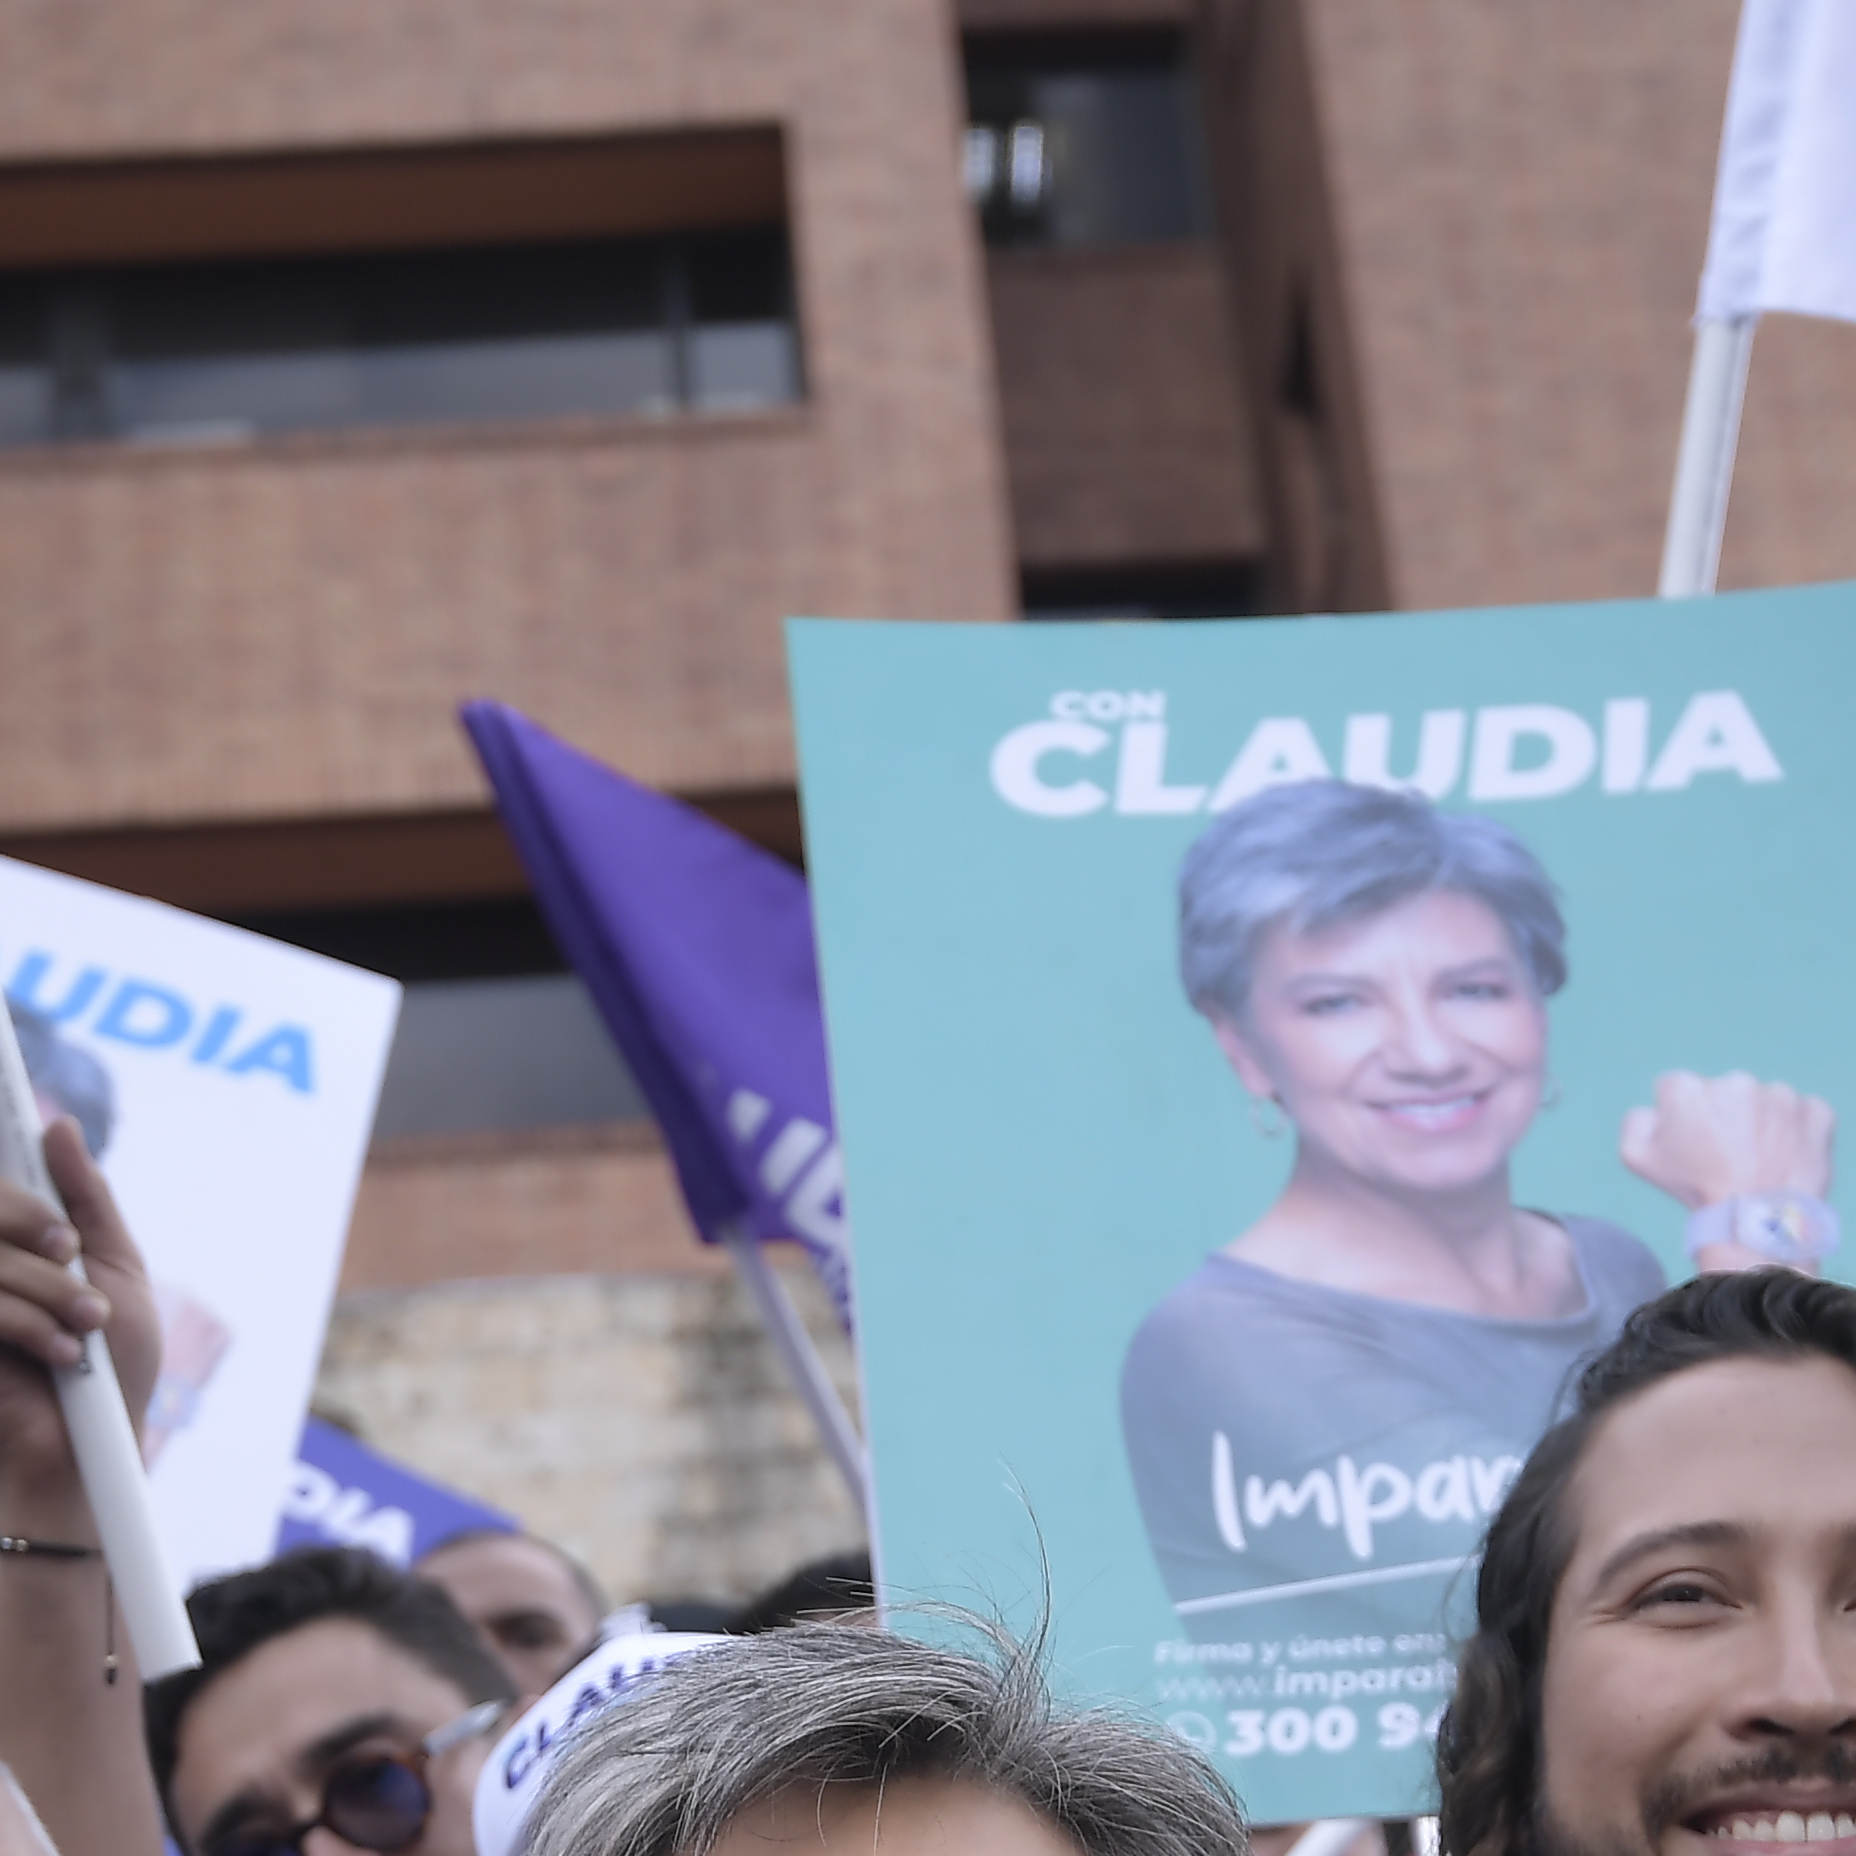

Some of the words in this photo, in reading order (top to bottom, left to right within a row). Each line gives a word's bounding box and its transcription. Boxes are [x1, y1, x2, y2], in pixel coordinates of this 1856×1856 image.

[1049, 690, 1167, 722] CON
[989, 690, 1785, 818] CLAUDIA
[1260, 1641, 1282, 1668] y
[1225, 1706, 1358, 1756] 300
